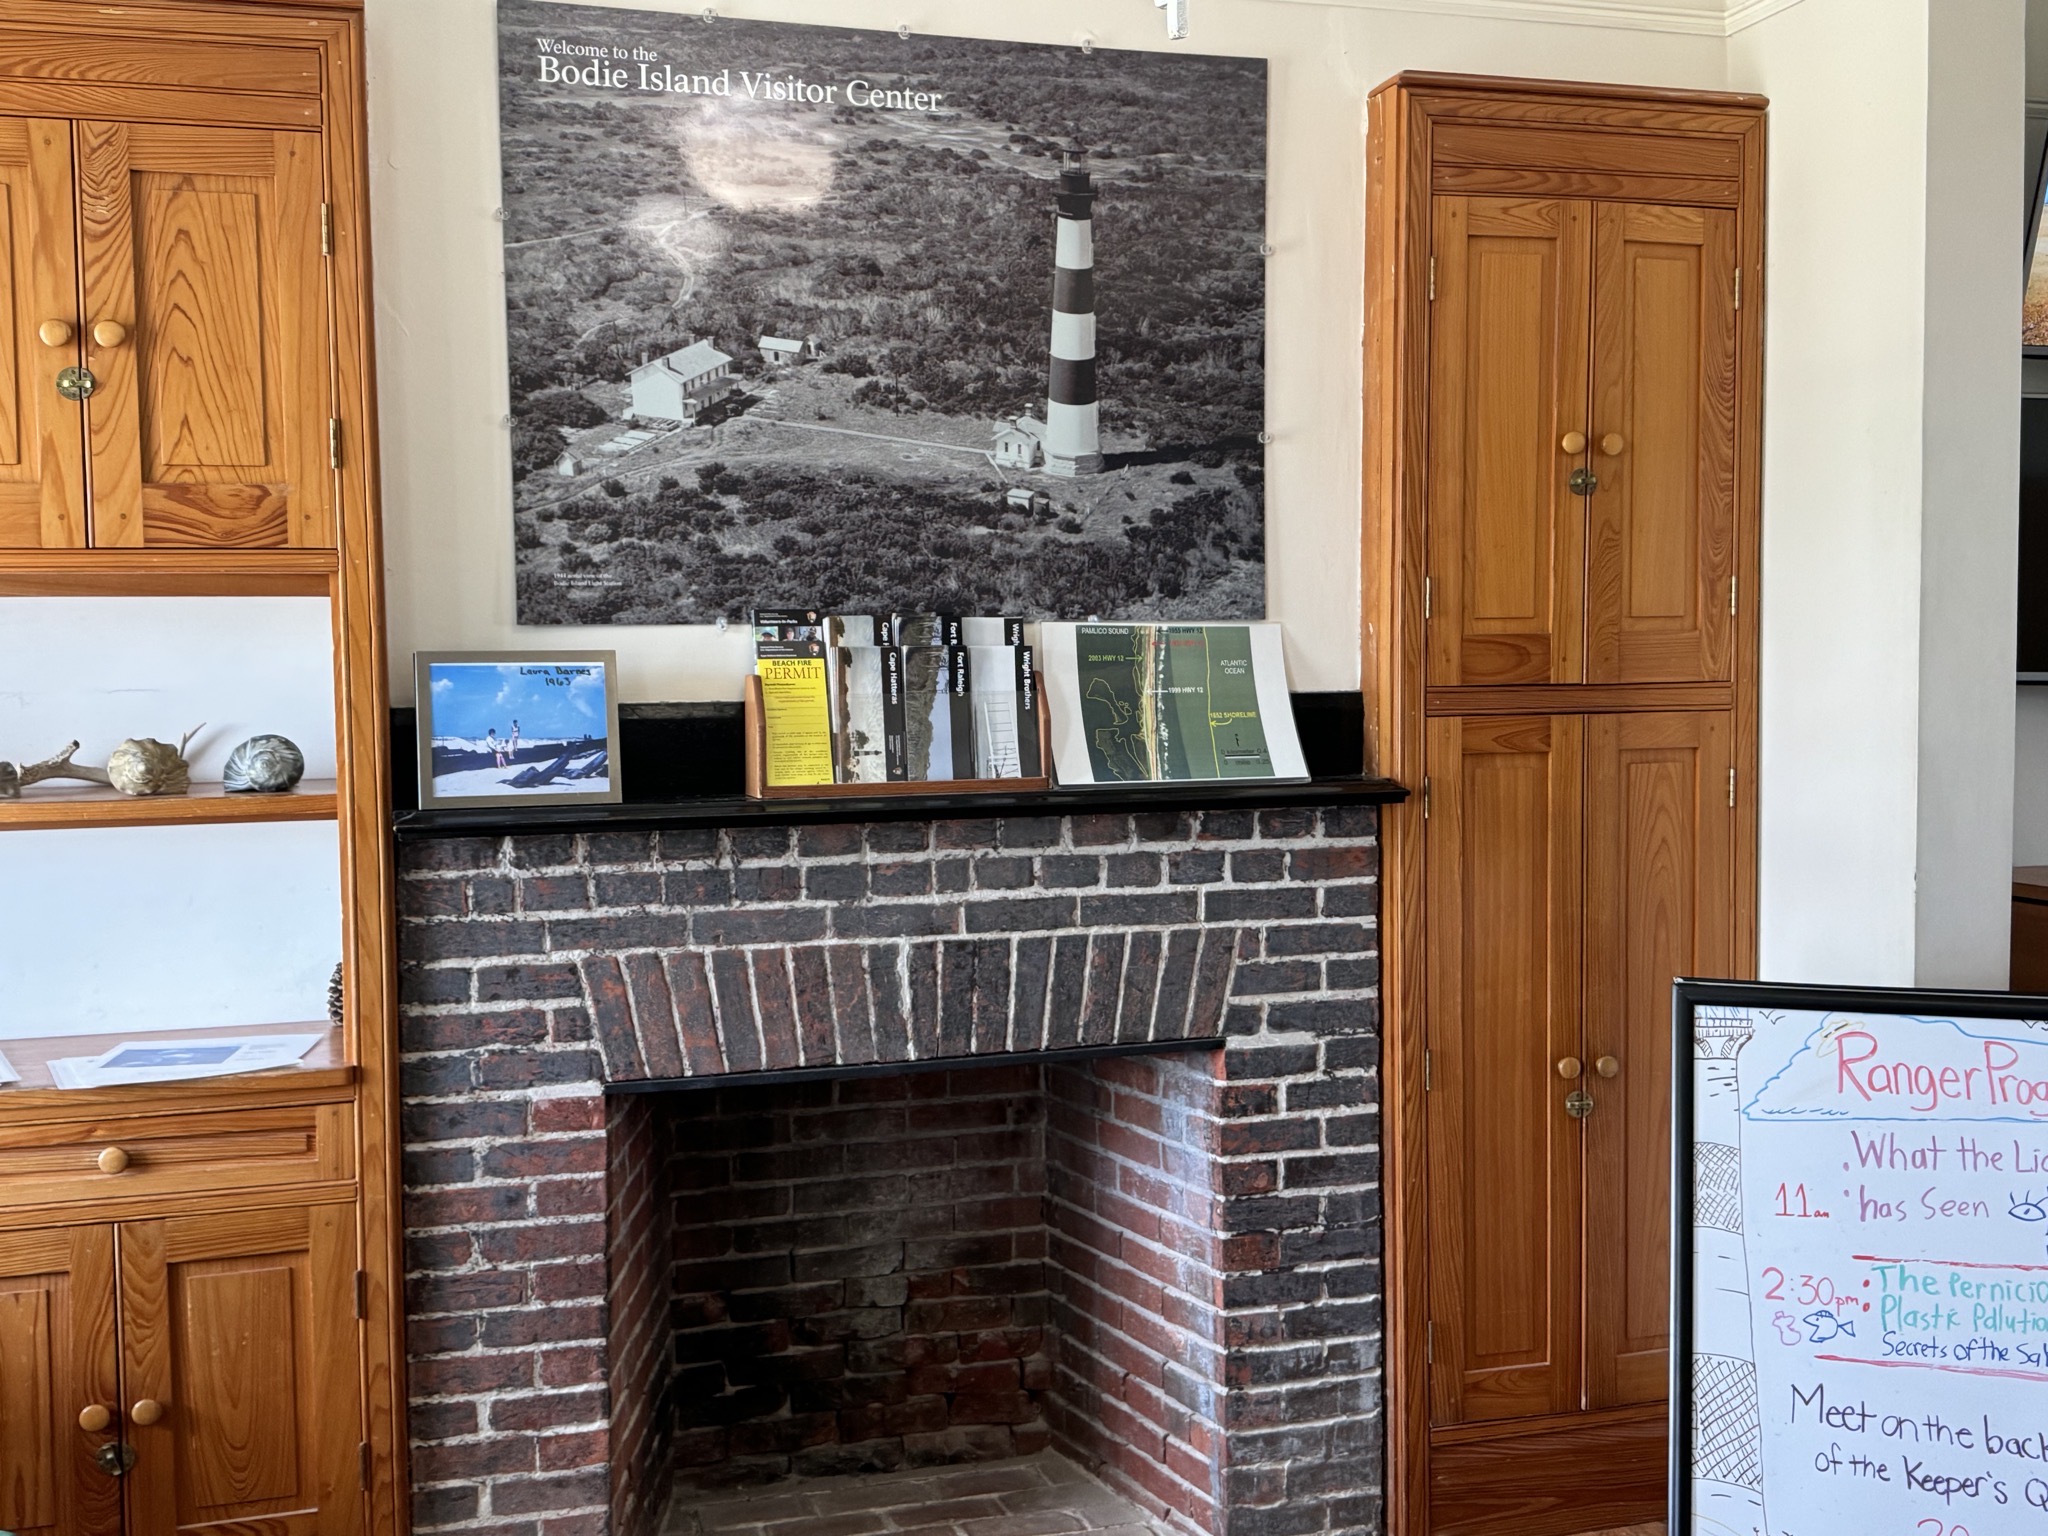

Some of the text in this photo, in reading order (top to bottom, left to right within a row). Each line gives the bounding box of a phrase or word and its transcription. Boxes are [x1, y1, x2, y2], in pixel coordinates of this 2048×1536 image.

[536, 37, 658, 62] Welcome to the
[537, 56, 942, 112] Bodie Island Visitor Center
[881, 622, 890, 642] Cape
[950, 622, 958, 638] Fort
[1081, 627, 1107, 635] PAMLICO
[520, 666, 591, 676] Laura Barnes
[764, 667, 822, 680] PERMIT
[889, 652, 898, 705] Cape Hatteras
[955, 652, 965, 697] Fort Raleigh
[1220, 659, 1248, 667] ATLANTIC
[545, 677, 571, 686] 1963
[1022, 651, 1032, 710] Wright Brothers
[1835, 1031, 1982, 1112] Ranger
[1850, 1130, 1947, 1172] What
[1957, 1136, 2003, 1172] the
[1860, 1184, 1906, 1222] has
[1871, 1263, 1940, 1297] The
[1882, 1330, 1947, 1359] Secrets
[1953, 1338, 1978, 1361] of
[1977, 1337, 2011, 1362] the
[1791, 1383, 1878, 1434] Meet
[1882, 1414, 1919, 1443] on
[1922, 1414, 1975, 1449] the
[1815, 1442, 1843, 1476] of
[1849, 1454, 1891, 1482] the
[1902, 1455, 2009, 1507] Keeper's
